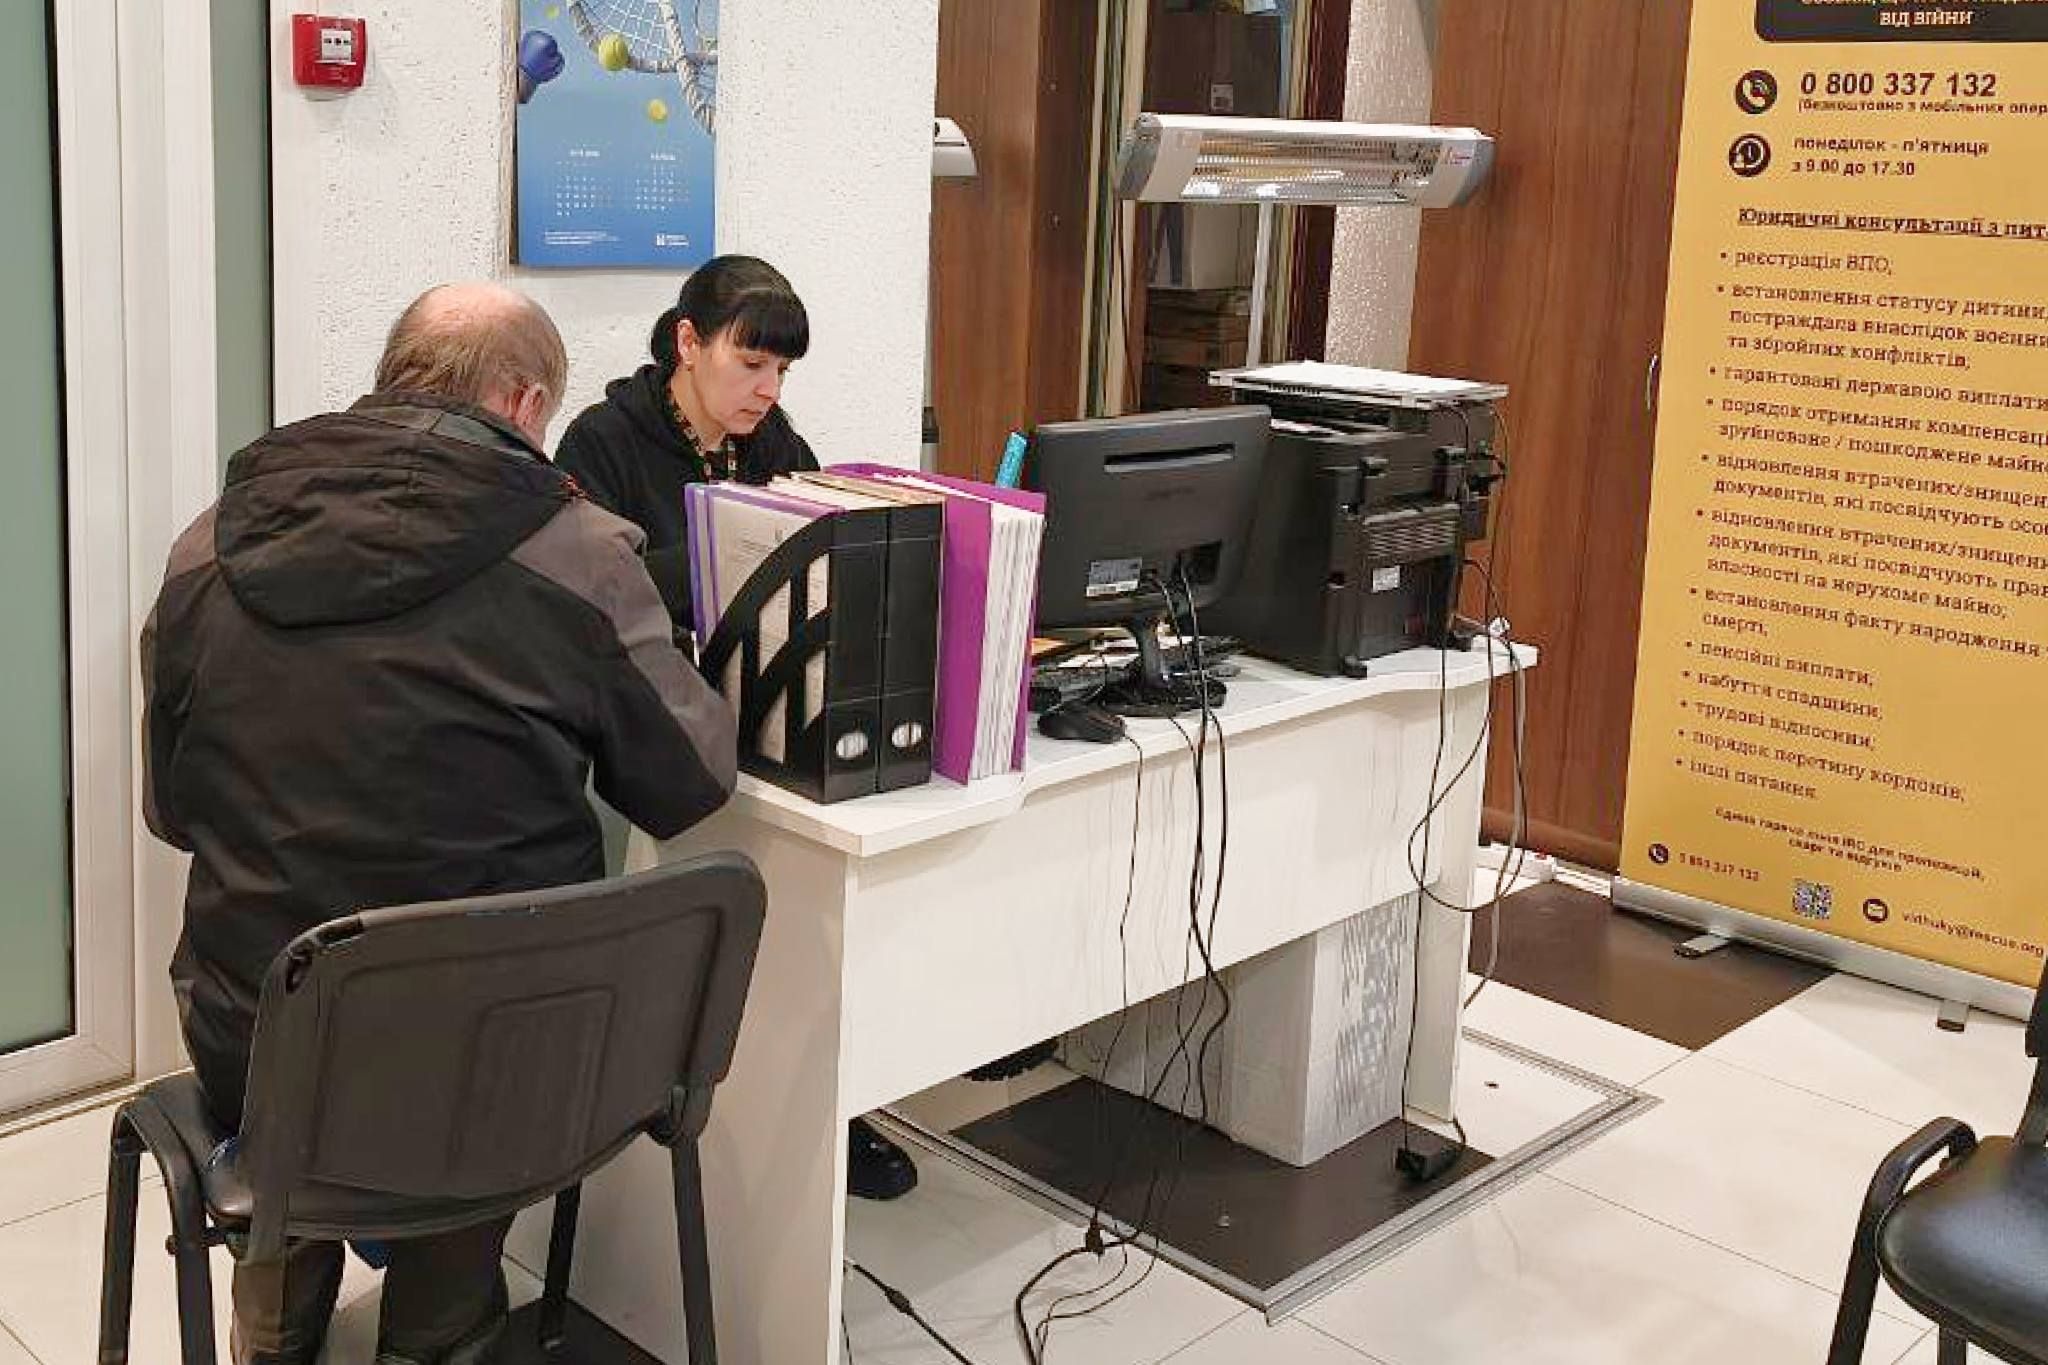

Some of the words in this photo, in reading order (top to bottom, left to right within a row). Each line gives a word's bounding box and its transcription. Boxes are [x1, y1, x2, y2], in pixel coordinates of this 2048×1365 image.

[1879, 11, 1910, 27] ВІД
[1801, 72, 1817, 95] 0
[1826, 72, 1875, 95] 800
[1883, 72, 1936, 96] 337
[1946, 72, 1997, 97] 132
[1794, 138, 1886, 153] понеділок
[1903, 137, 1990, 157] п'ятниця
[1792, 161, 1801, 172] з
[1806, 159, 1840, 173] 9.00
[1842, 161, 1866, 176] до
[1872, 160, 1915, 176] 17.30
[1739, 208, 1840, 228] Юридичні
[1846, 211, 1982, 235] консультації
[2004, 223, 2048, 239] пит
[1734, 251, 1841, 270] реєстрація
[1732, 284, 1873, 306] встановлення
[1877, 295, 1958, 316] статусу
[1730, 310, 1857, 331] постраждала
[1864, 320, 1968, 342] внаслідок
[1729, 336, 1748, 349] та
[1753, 335, 1846, 357] збройних
[1724, 366, 1841, 391] гарантовані
[1846, 379, 1953, 402] державою
[1722, 398, 1802, 418] порядок
[1807, 408, 1922, 431] отримання
[1719, 424, 1831, 448] зруйноване
[1848, 438, 1983, 465] пошкоджене
[1717, 453, 1841, 481] відновлення
[1832, 494, 1864, 511] які
[1869, 499, 2005, 530] посвідчують
[1711, 509, 1835, 540] відновлення
[1840, 527, 2048, 571] втрачених/знищен
[1707, 557, 1800, 584] власності
[1804, 573, 1828, 589] на
[1831, 577, 1931, 605] нерухоме
[1828, 550, 1858, 568] які
[1863, 556, 1999, 587] посвідчують
[1705, 587, 1840, 623] встановлення
[1843, 608, 1904, 635] факту
[1909, 622, 2041, 657] народження
[1701, 642, 1781, 668] пенсійні
[1698, 672, 1773, 699] набуття
[1695, 701, 1765, 727] трудові
[1692, 731, 1771, 757] порядок
[1774, 749, 1867, 781] перетину
